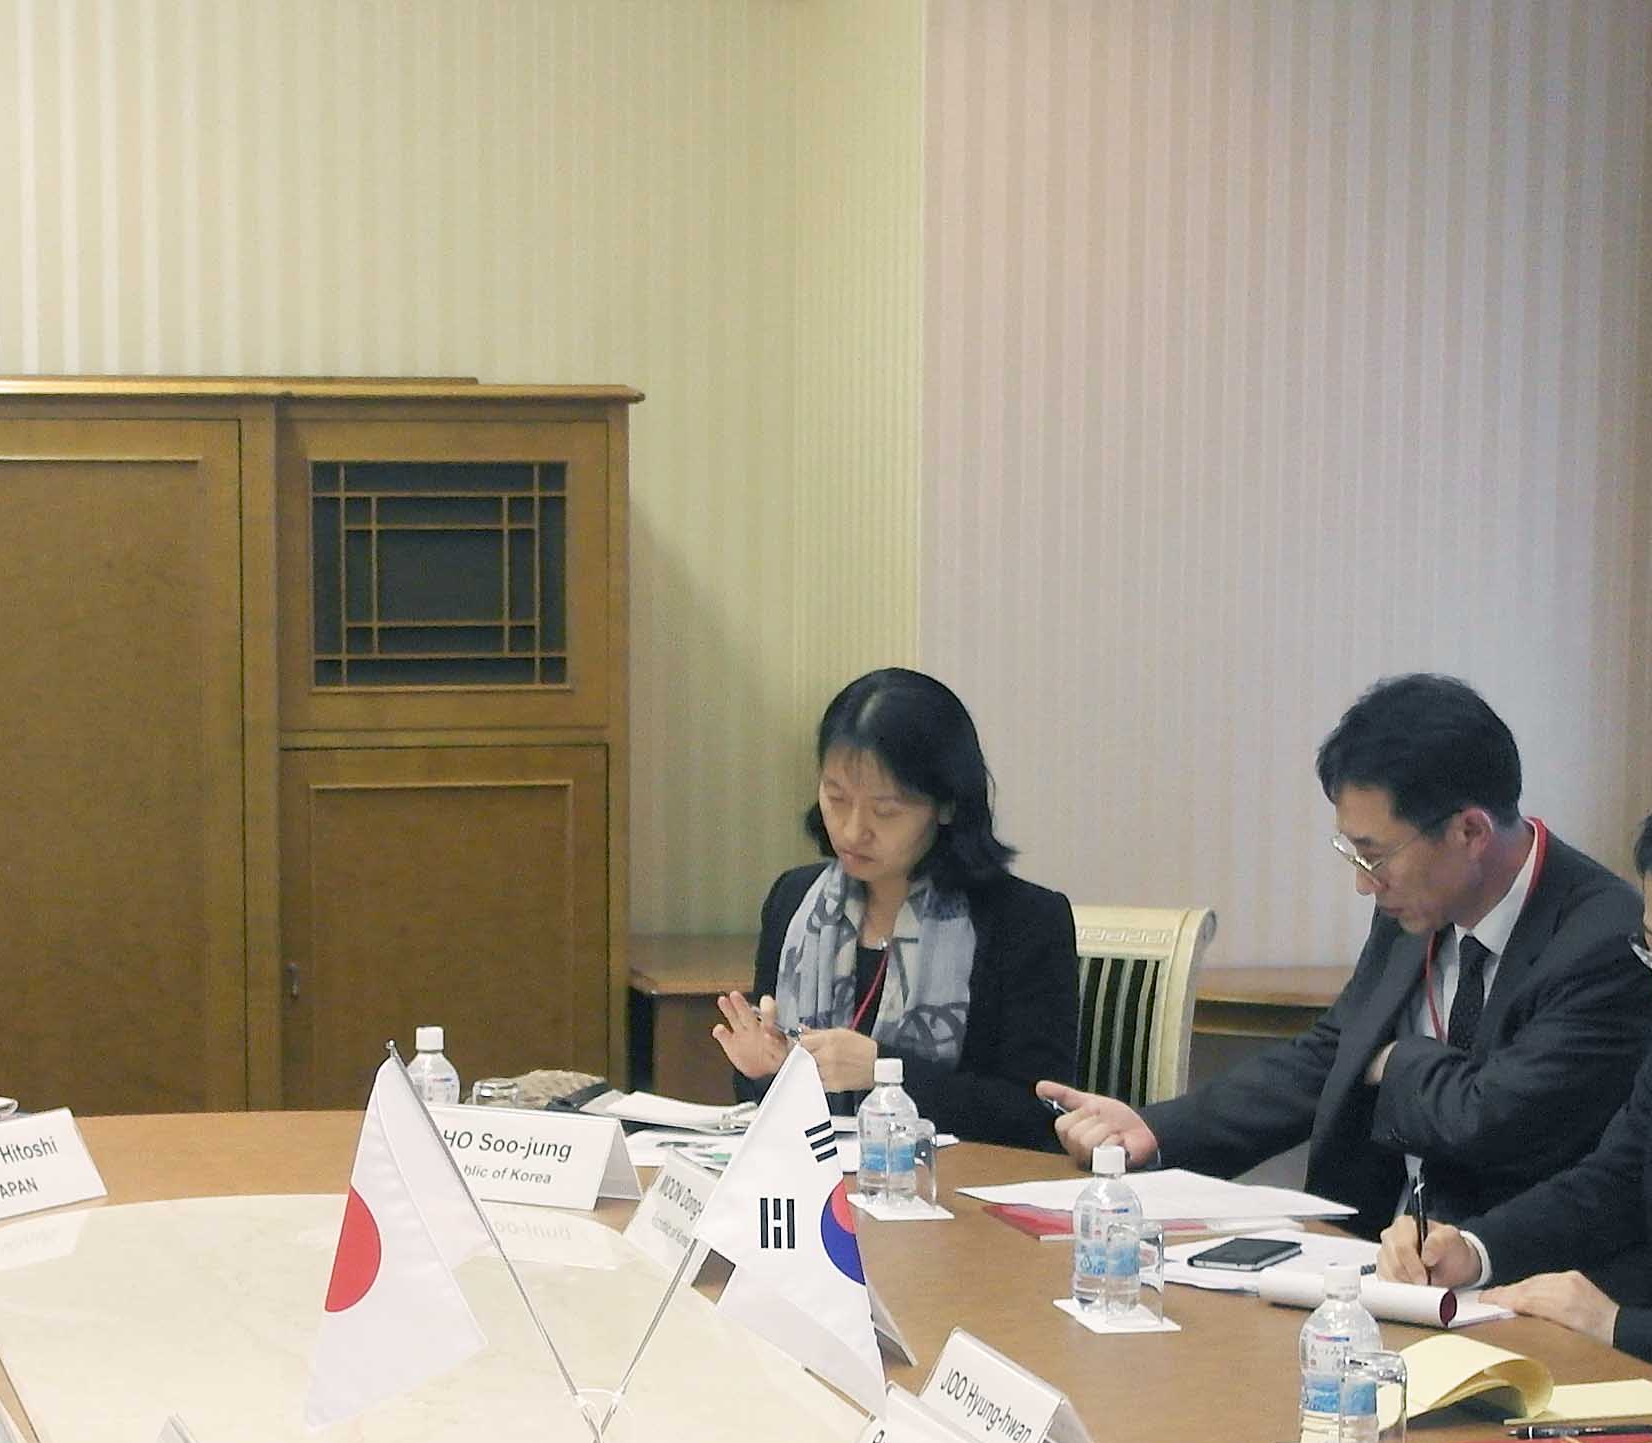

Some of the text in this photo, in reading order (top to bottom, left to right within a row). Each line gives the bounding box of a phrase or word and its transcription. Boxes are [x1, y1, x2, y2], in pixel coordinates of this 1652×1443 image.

[0, 1136, 59, 1165] Hitoshi
[443, 1129, 572, 1163] HO Soo-jung
[463, 1163, 552, 1185] blic of Korea
[940, 1368, 968, 1401] JOO
